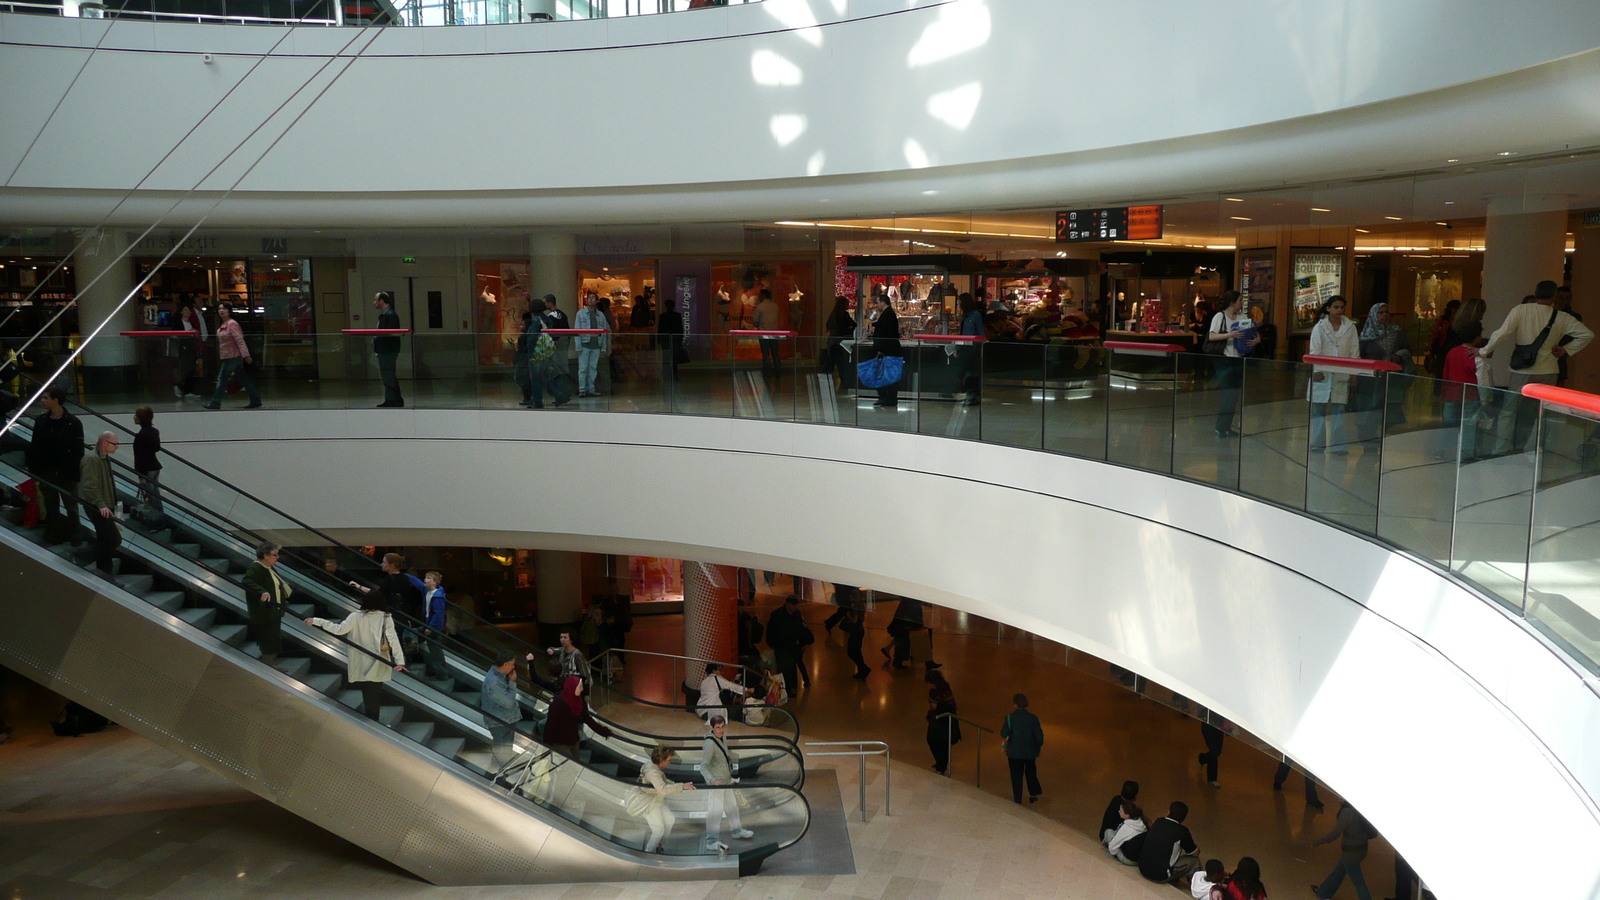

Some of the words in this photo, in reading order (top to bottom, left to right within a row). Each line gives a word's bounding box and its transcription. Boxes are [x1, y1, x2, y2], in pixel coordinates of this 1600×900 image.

[1057, 217, 1067, 240] 2
[1296, 255, 1340, 264] COMMERCE
[682, 276, 693, 309] Lingerie
[1242, 289, 1249, 297] LE
